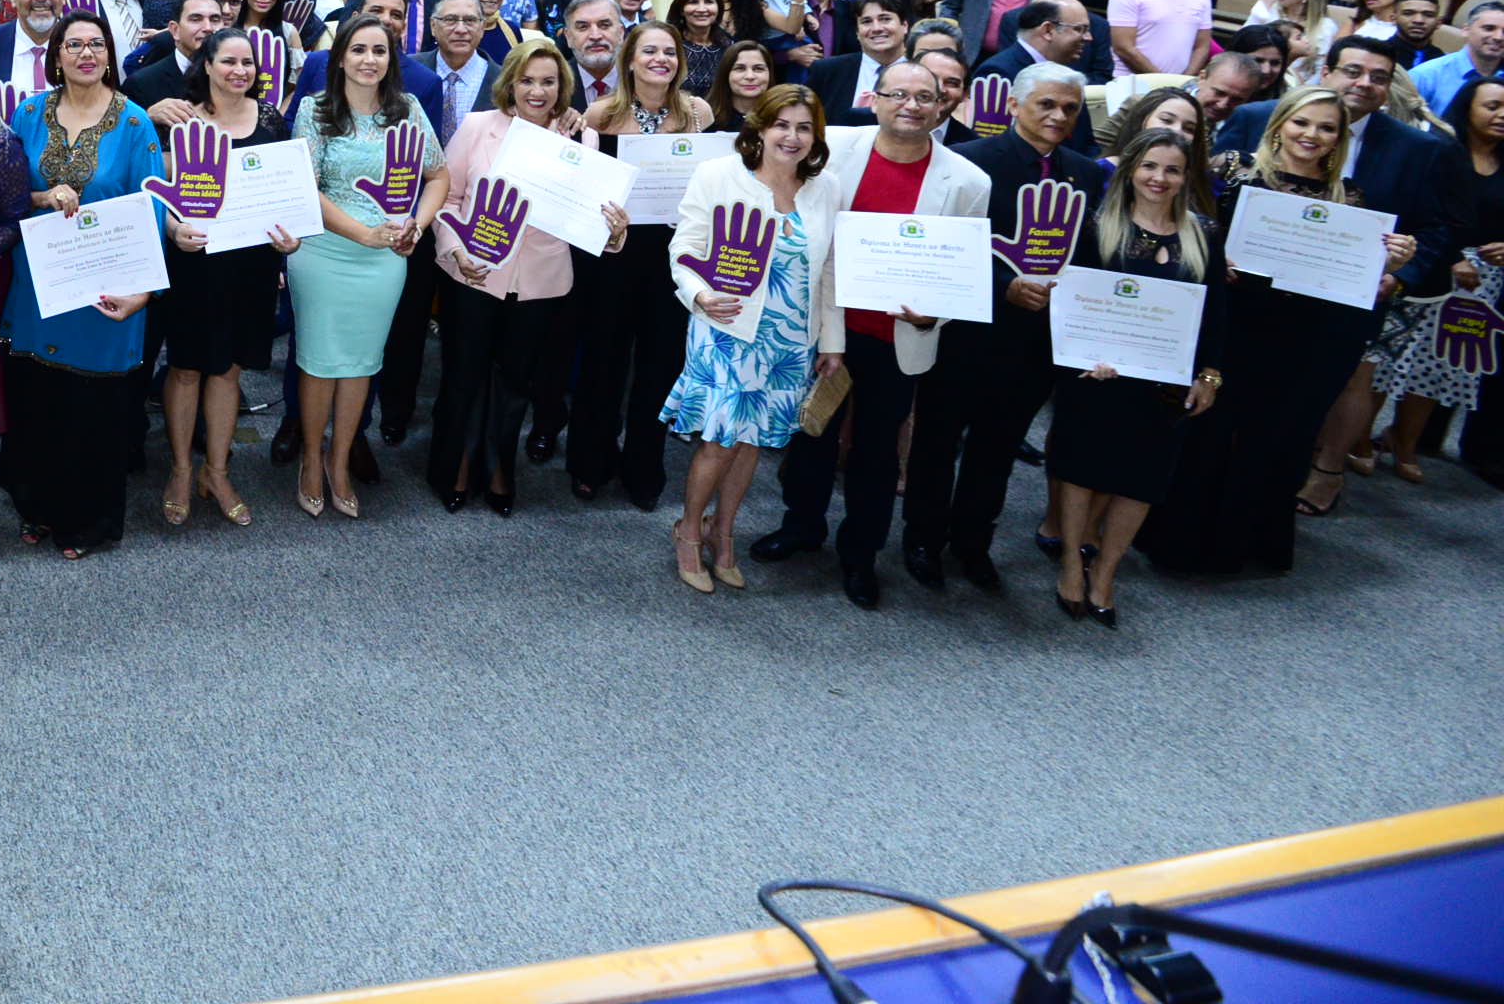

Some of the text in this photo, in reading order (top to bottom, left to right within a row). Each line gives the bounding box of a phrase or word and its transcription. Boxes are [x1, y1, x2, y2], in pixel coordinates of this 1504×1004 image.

[195, 182, 221, 190] desista
[485, 218, 504, 228] amor
[1028, 228, 1065, 236] Família
[728, 248, 751, 256] amor
[1025, 247, 1066, 255] alicerce!
[730, 255, 757, 264] pátria
[717, 261, 748, 271] começa
[716, 266, 745, 278] Família
